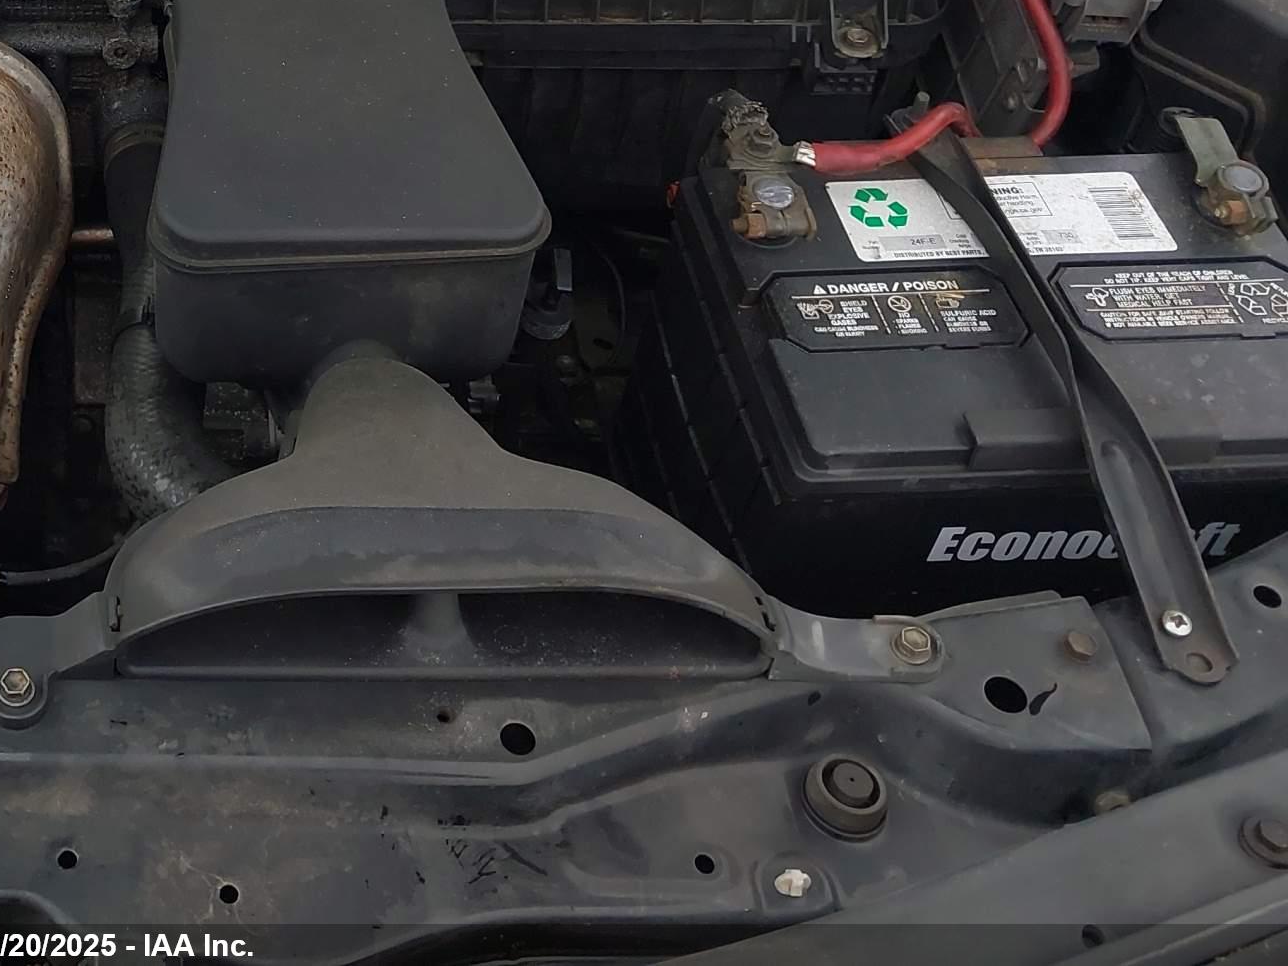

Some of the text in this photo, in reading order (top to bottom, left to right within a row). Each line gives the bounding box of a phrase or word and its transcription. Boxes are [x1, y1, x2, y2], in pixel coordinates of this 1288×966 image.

[910, 237, 938, 246] 24F-E
[827, 279, 960, 294] DANGER / POISON
[1108, 285, 1206, 295] FLUSH EYES IMMEDIATELY
[1112, 294, 1133, 302] WITH
[1163, 292, 1180, 300] GET
[1116, 300, 1153, 308] MEDICAL
[1152, 299, 1172, 307] HELP
[842, 306, 864, 314] EYES
[826, 312, 871, 320] EXPLOSIVE
[926, 521, 1240, 562] Econocft
